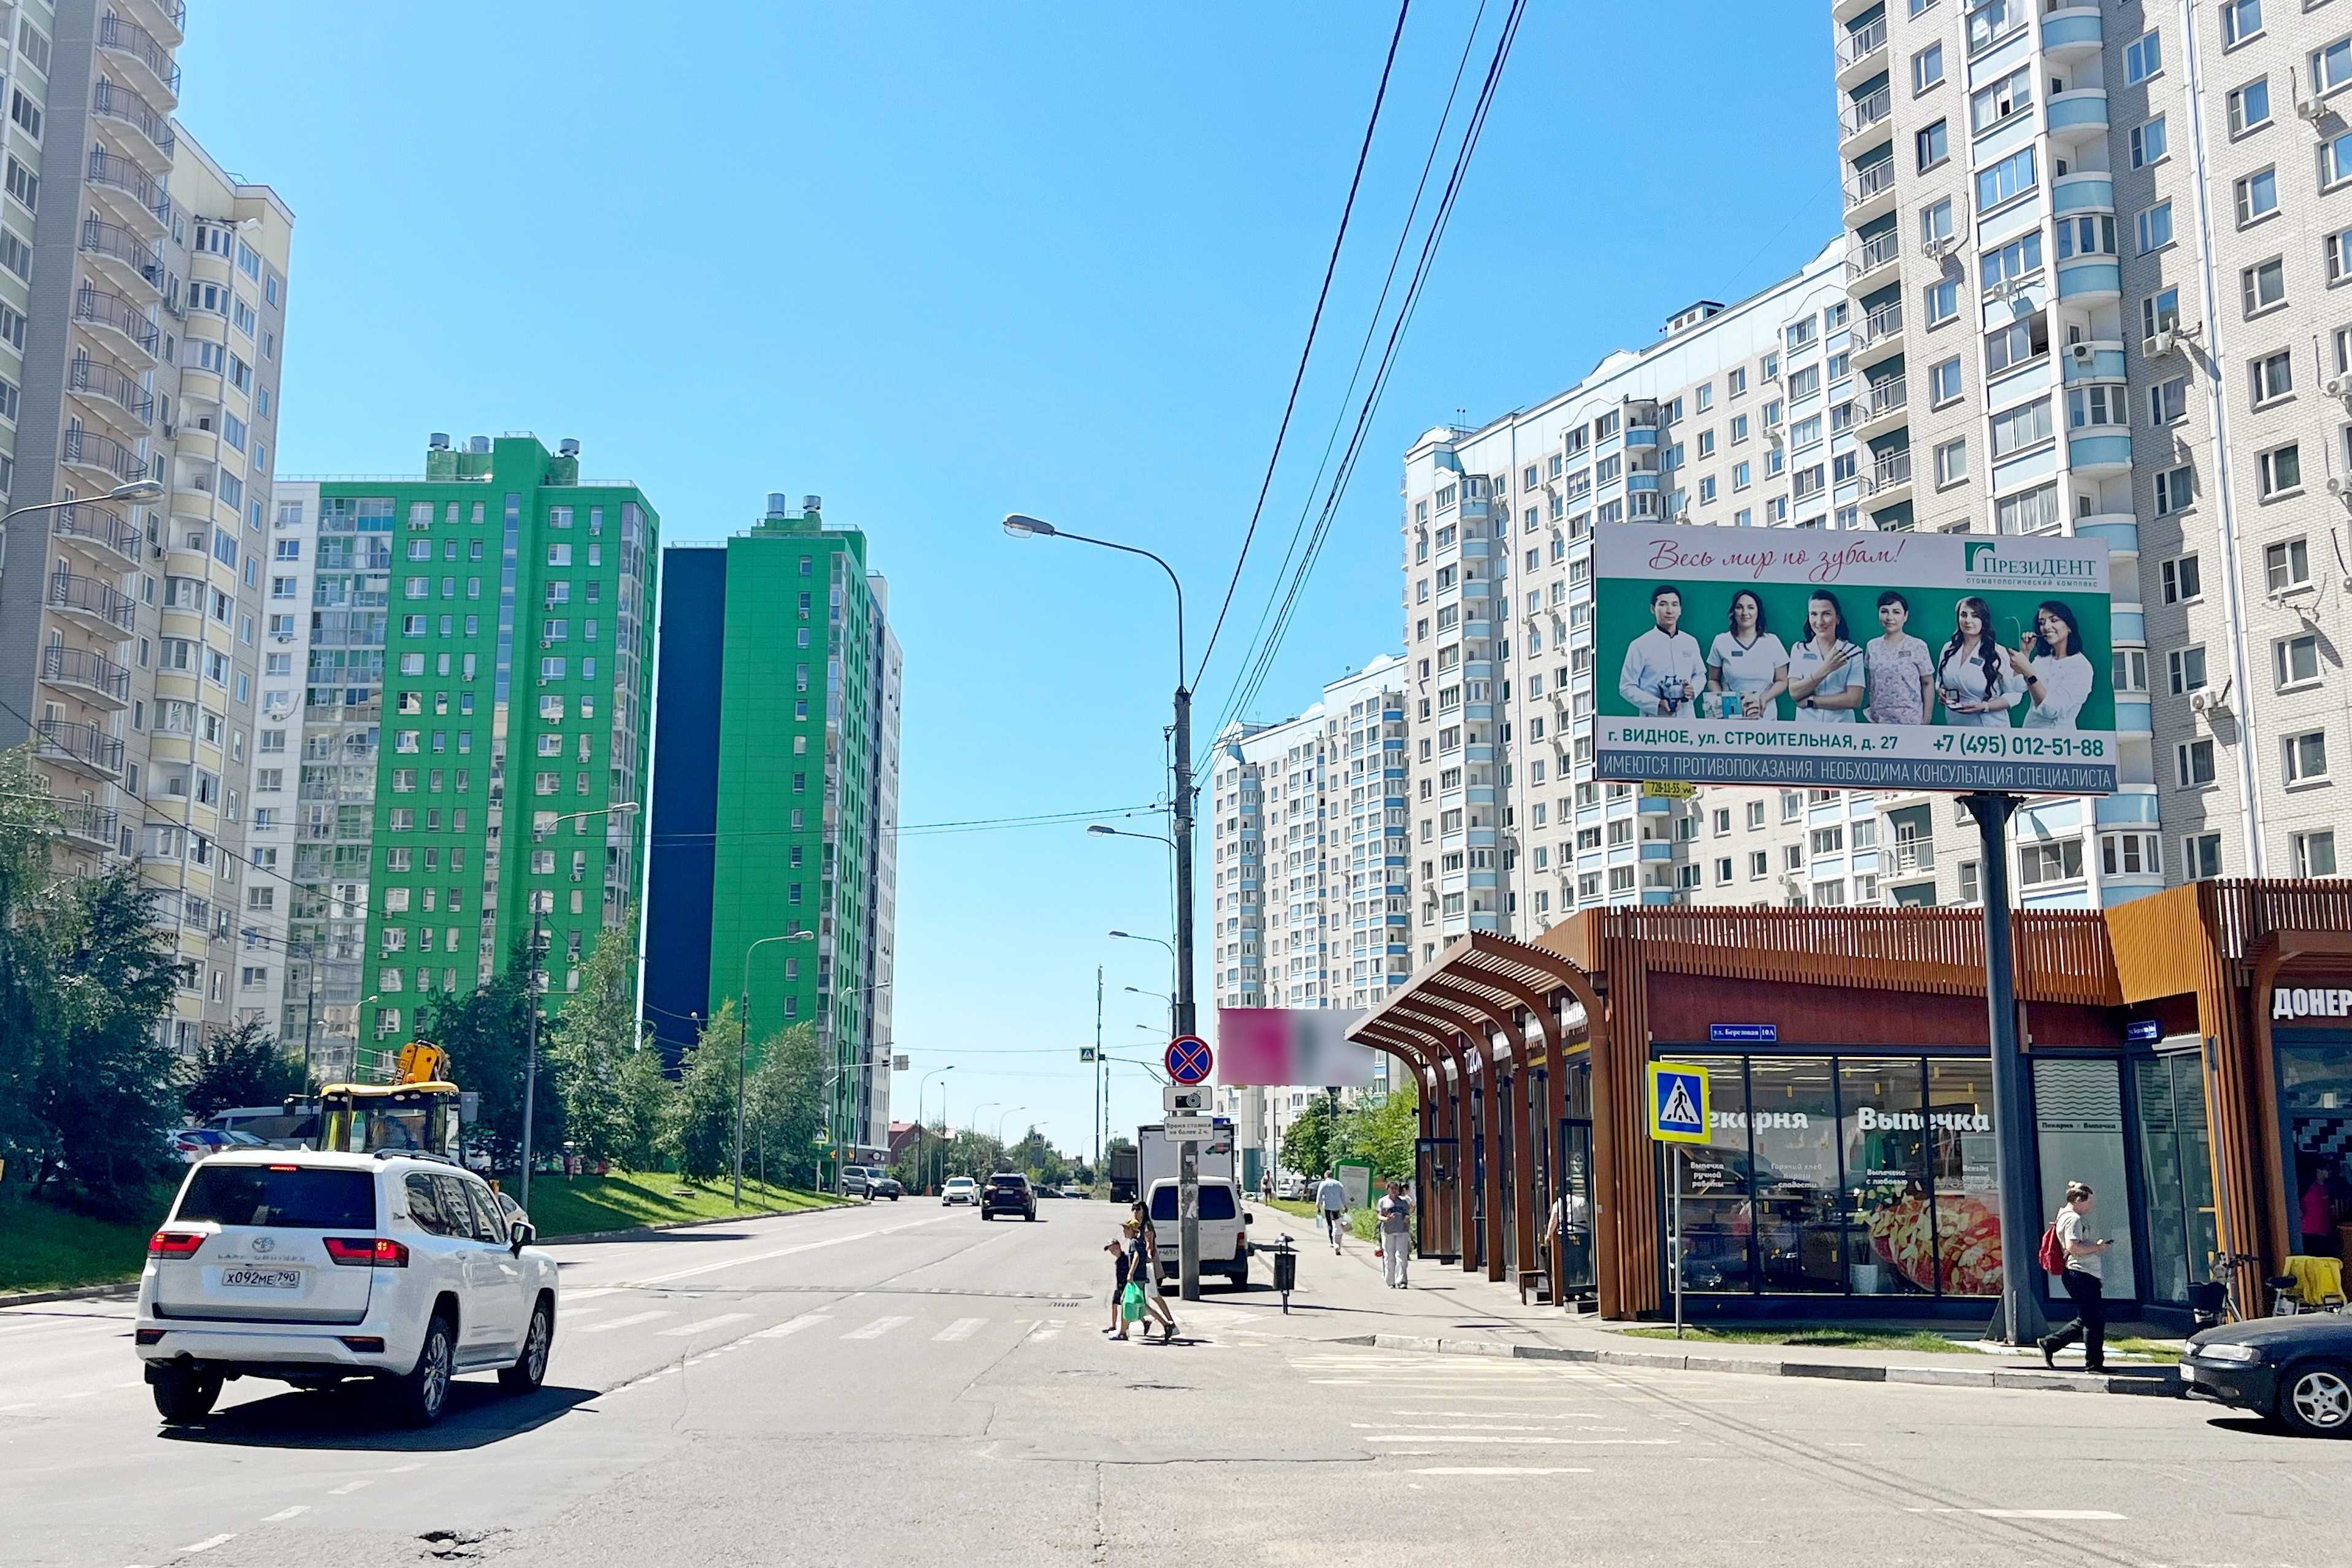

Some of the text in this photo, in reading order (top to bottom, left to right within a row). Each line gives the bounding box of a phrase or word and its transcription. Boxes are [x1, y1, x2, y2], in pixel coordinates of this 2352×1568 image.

[1648, 539, 1907, 583] Весь мир по зубам!
[1966, 577, 2053, 586] стоматологический
[1607, 728, 1899, 751] г. ВИДНОЕ, ул. СТРОИТЕЛЬНАЯ, д. 27
[1933, 732, 2104, 758] +7 (495) 012-51-88
[1604, 755, 2112, 789] ИМЕЮТСЯ ПРОТИВОПОКАЗАНИЯ. НЕОБХОДИМА КОНСУЛЬТАЦИЯ СПЕЦИАЛИСТА
[1650, 781, 1680, 793] 728-11-55
[2273, 988, 2352, 1020] ДОНЕР
[1709, 1111, 1809, 1135] екарня
[1858, 1107, 1991, 1132] Выпечка
[1690, 1161, 1724, 1170] Выпечка
[1693, 1171, 1722, 1180] ручной
[1692, 1180, 1724, 1189] работы
